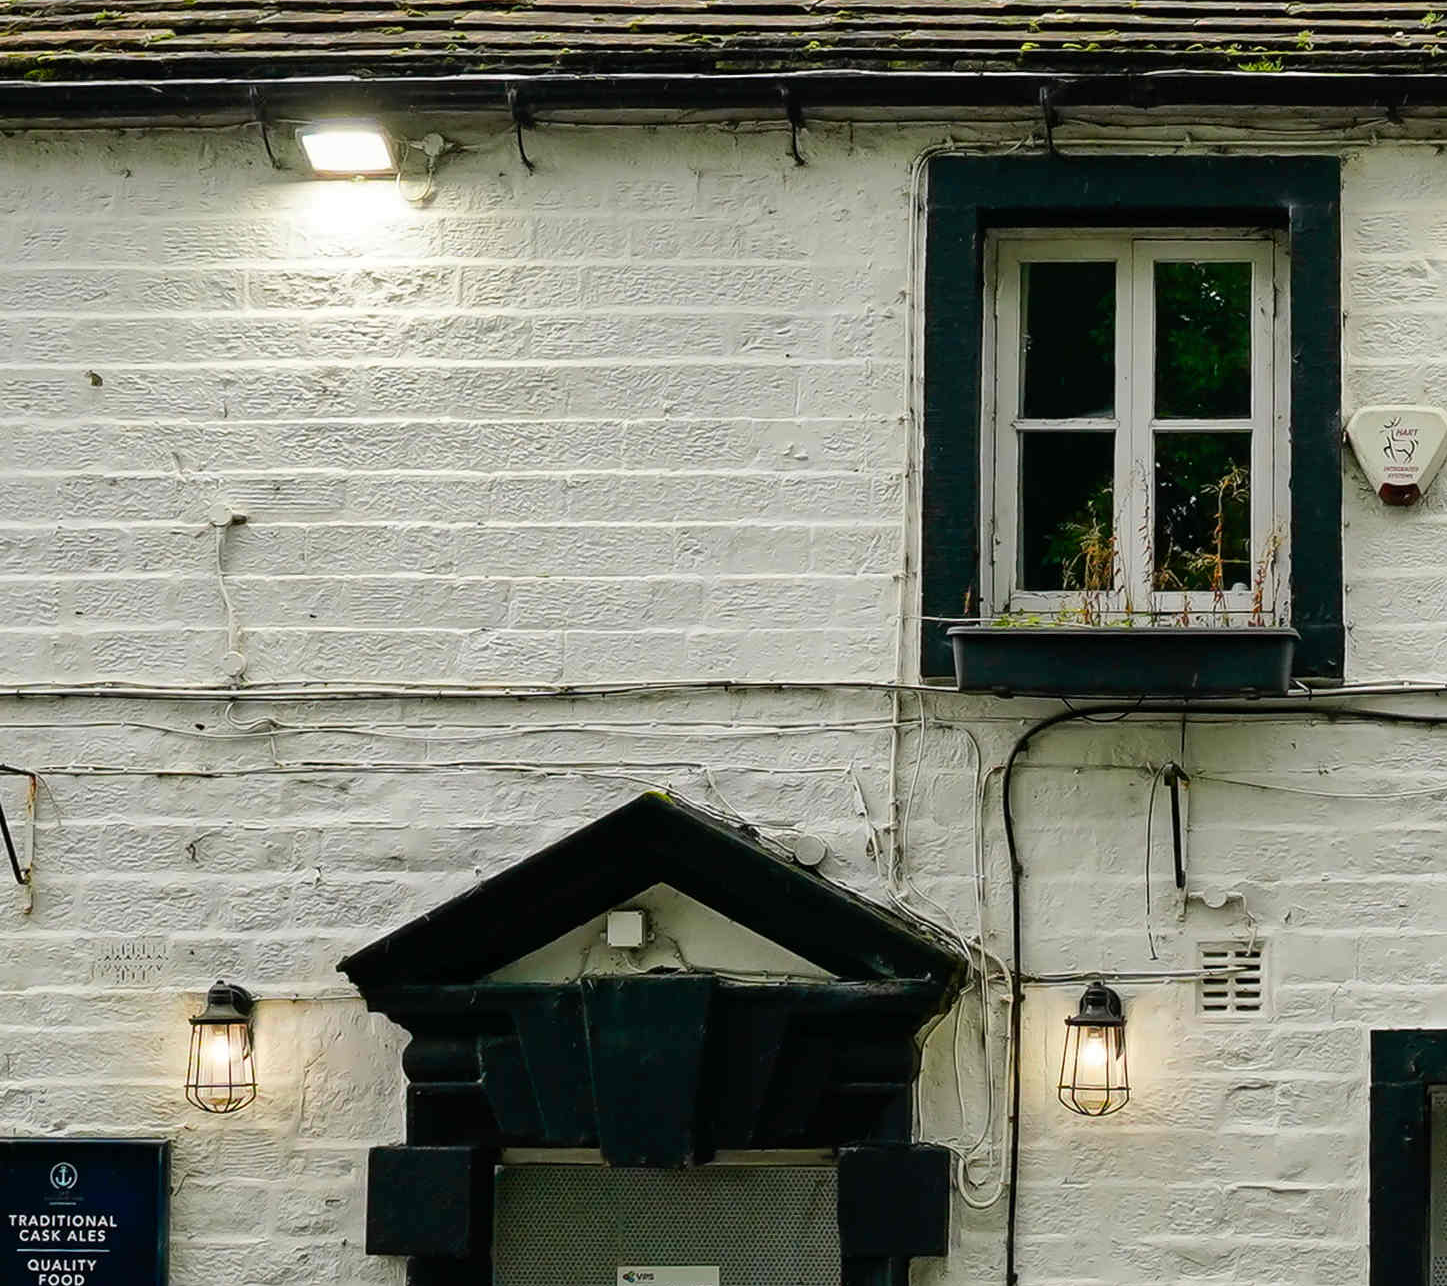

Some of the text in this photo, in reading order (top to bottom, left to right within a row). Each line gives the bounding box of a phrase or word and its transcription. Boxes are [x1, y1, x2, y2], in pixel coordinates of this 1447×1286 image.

[8, 1214, 118, 1227] TRADITIONAL
[19, 1229, 106, 1242] CASK ALES
[27, 1259, 97, 1272] QUALITY
[38, 1274, 85, 1286] FOOD
[636, 1273, 655, 1281] VPS
